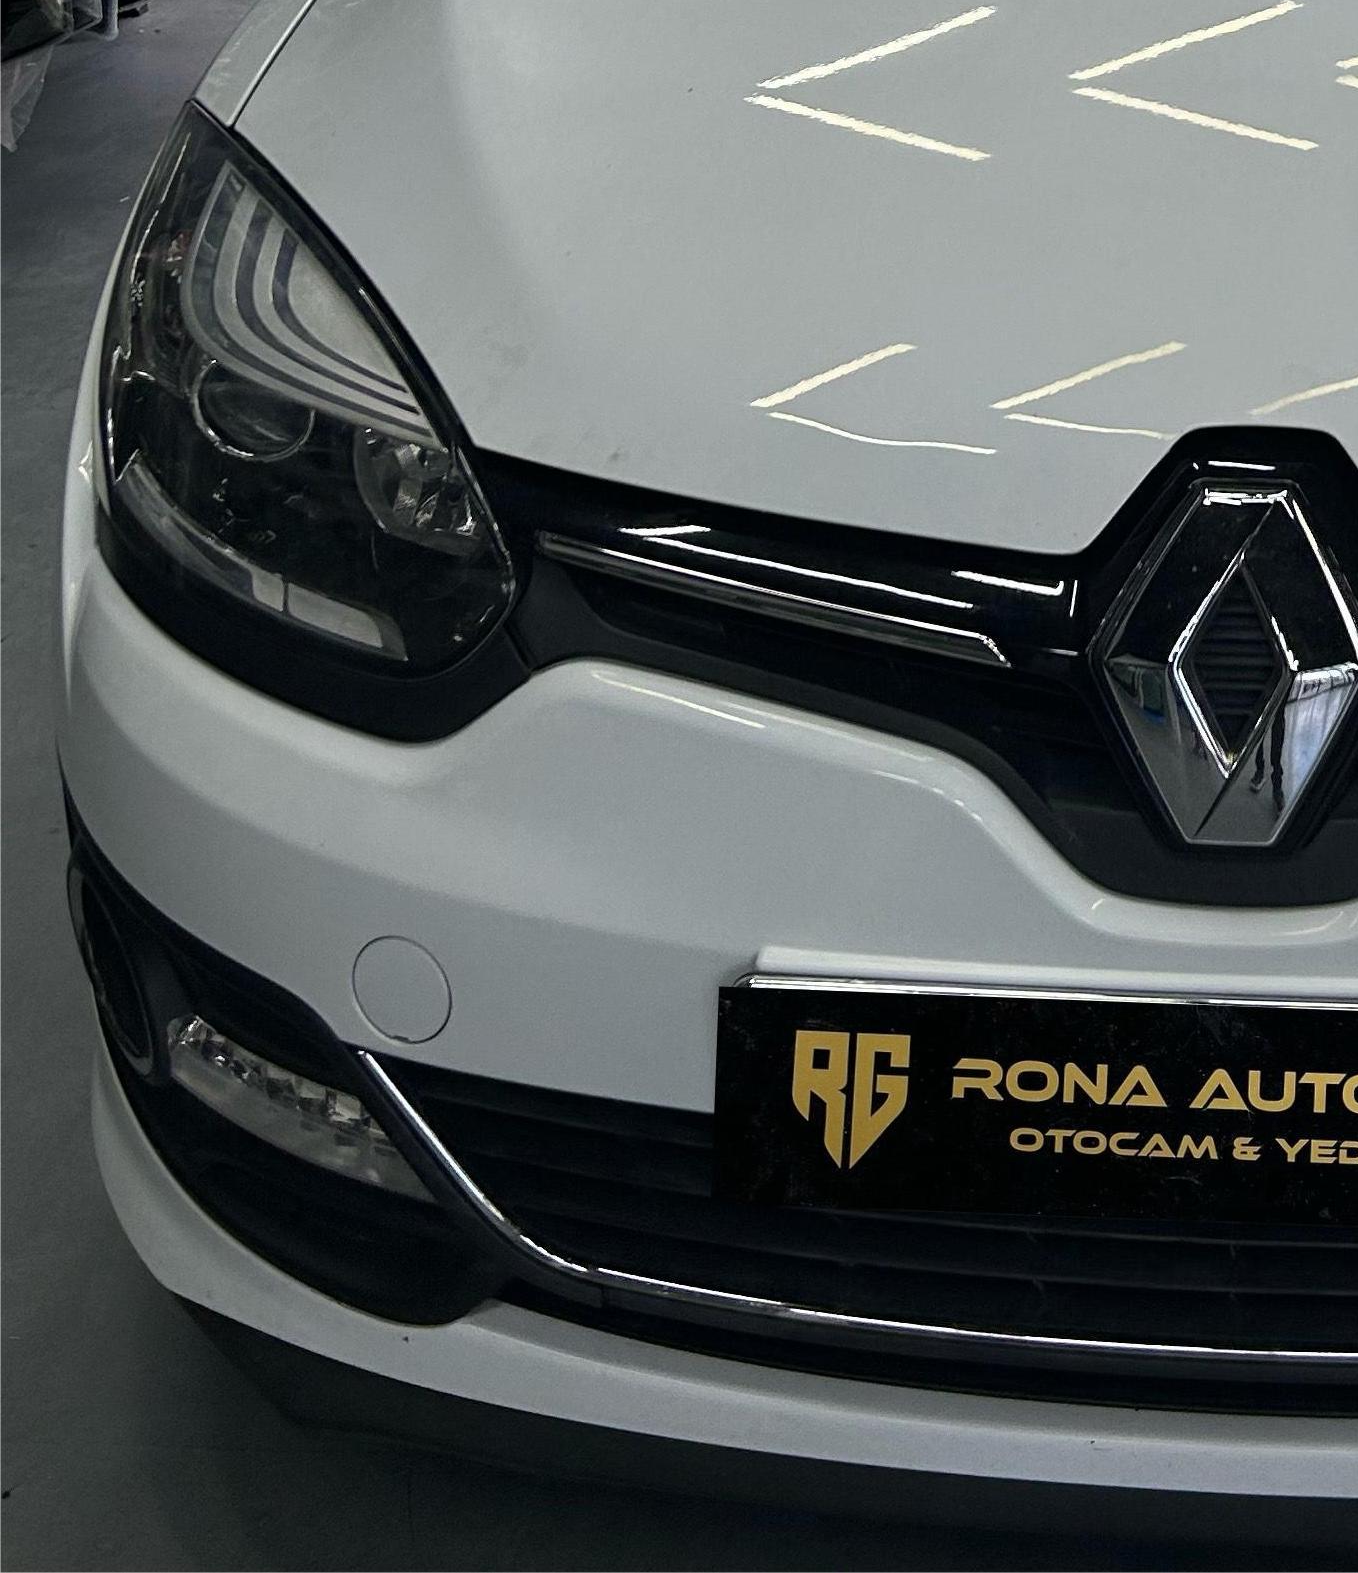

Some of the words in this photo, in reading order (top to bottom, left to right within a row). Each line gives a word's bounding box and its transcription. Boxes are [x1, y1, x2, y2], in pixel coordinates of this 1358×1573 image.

[791, 1029, 911, 1169] RG
[951, 1058, 1167, 1108] RONA
[1009, 1127, 1218, 1160] OTOCAM
[1232, 1136, 1262, 1162] &
